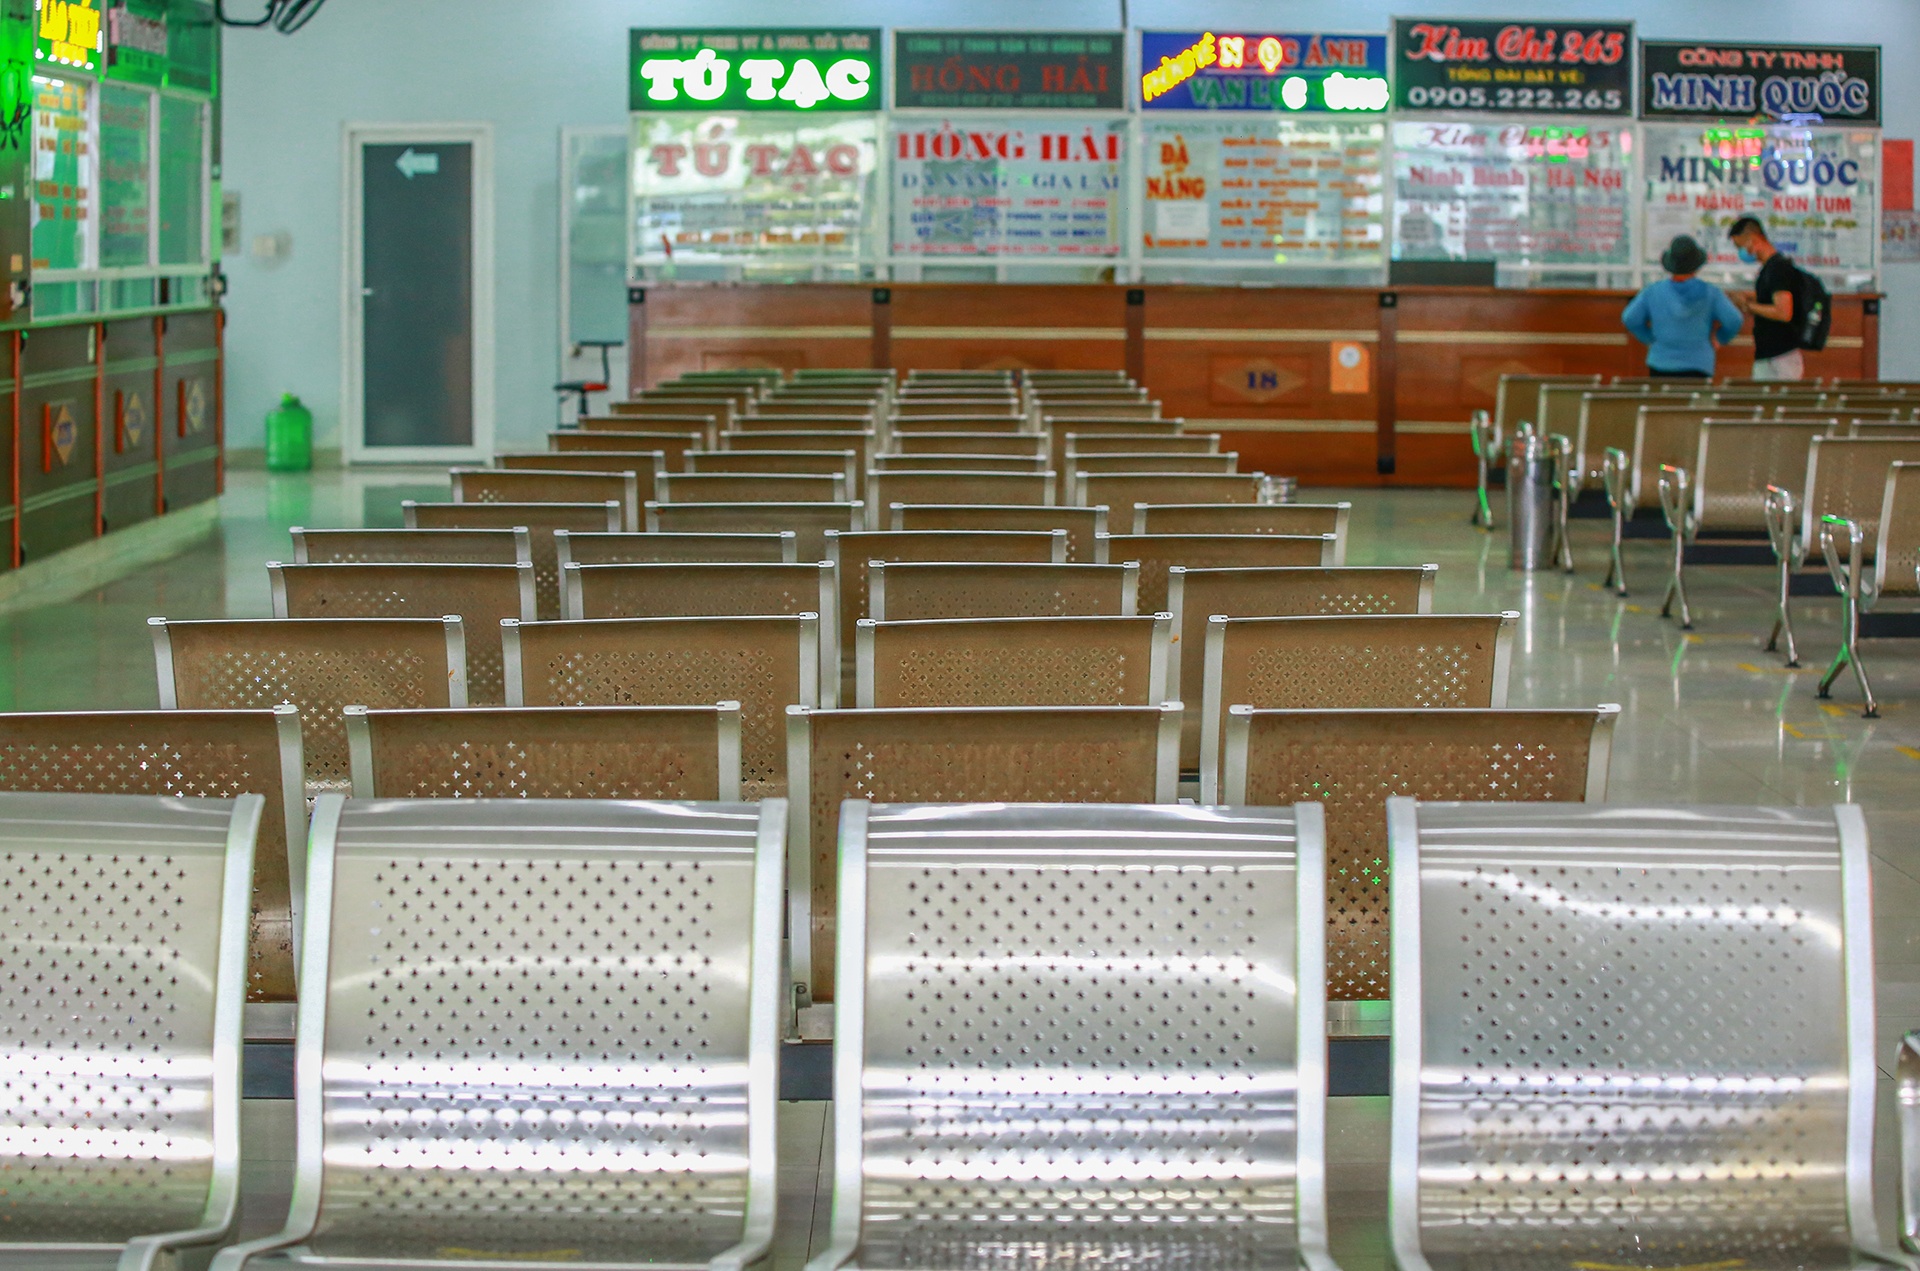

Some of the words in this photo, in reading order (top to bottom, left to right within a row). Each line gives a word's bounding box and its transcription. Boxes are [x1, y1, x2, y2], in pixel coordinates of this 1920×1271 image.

[1218, 37, 1299, 72] NGỌC
[1305, 34, 1367, 67] ÁNH
[1406, 24, 1490, 61] Kim
[1560, 31, 1625, 63] 265
[1678, 47, 1743, 67] CÔNG
[1748, 52, 1776, 68] TY
[1781, 53, 1844, 69] TNHH
[739, 59, 871, 108] TẠC
[1041, 55, 1109, 93] HẢI
[1408, 86, 1622, 110] 0905.222.265
[1653, 72, 1756, 111] MINH
[1761, 71, 1869, 119] QUỐC
[1041, 126, 1119, 162] HẢI
[745, 144, 859, 192] TẠC
[1583, 167, 1622, 194] Nội
[1660, 155, 1749, 183] MINH
[1763, 152, 1858, 190] QUỐC
[1773, 195, 1808, 212] KON
[1816, 196, 1852, 213] TUM
[1248, 371, 1277, 389] 18
